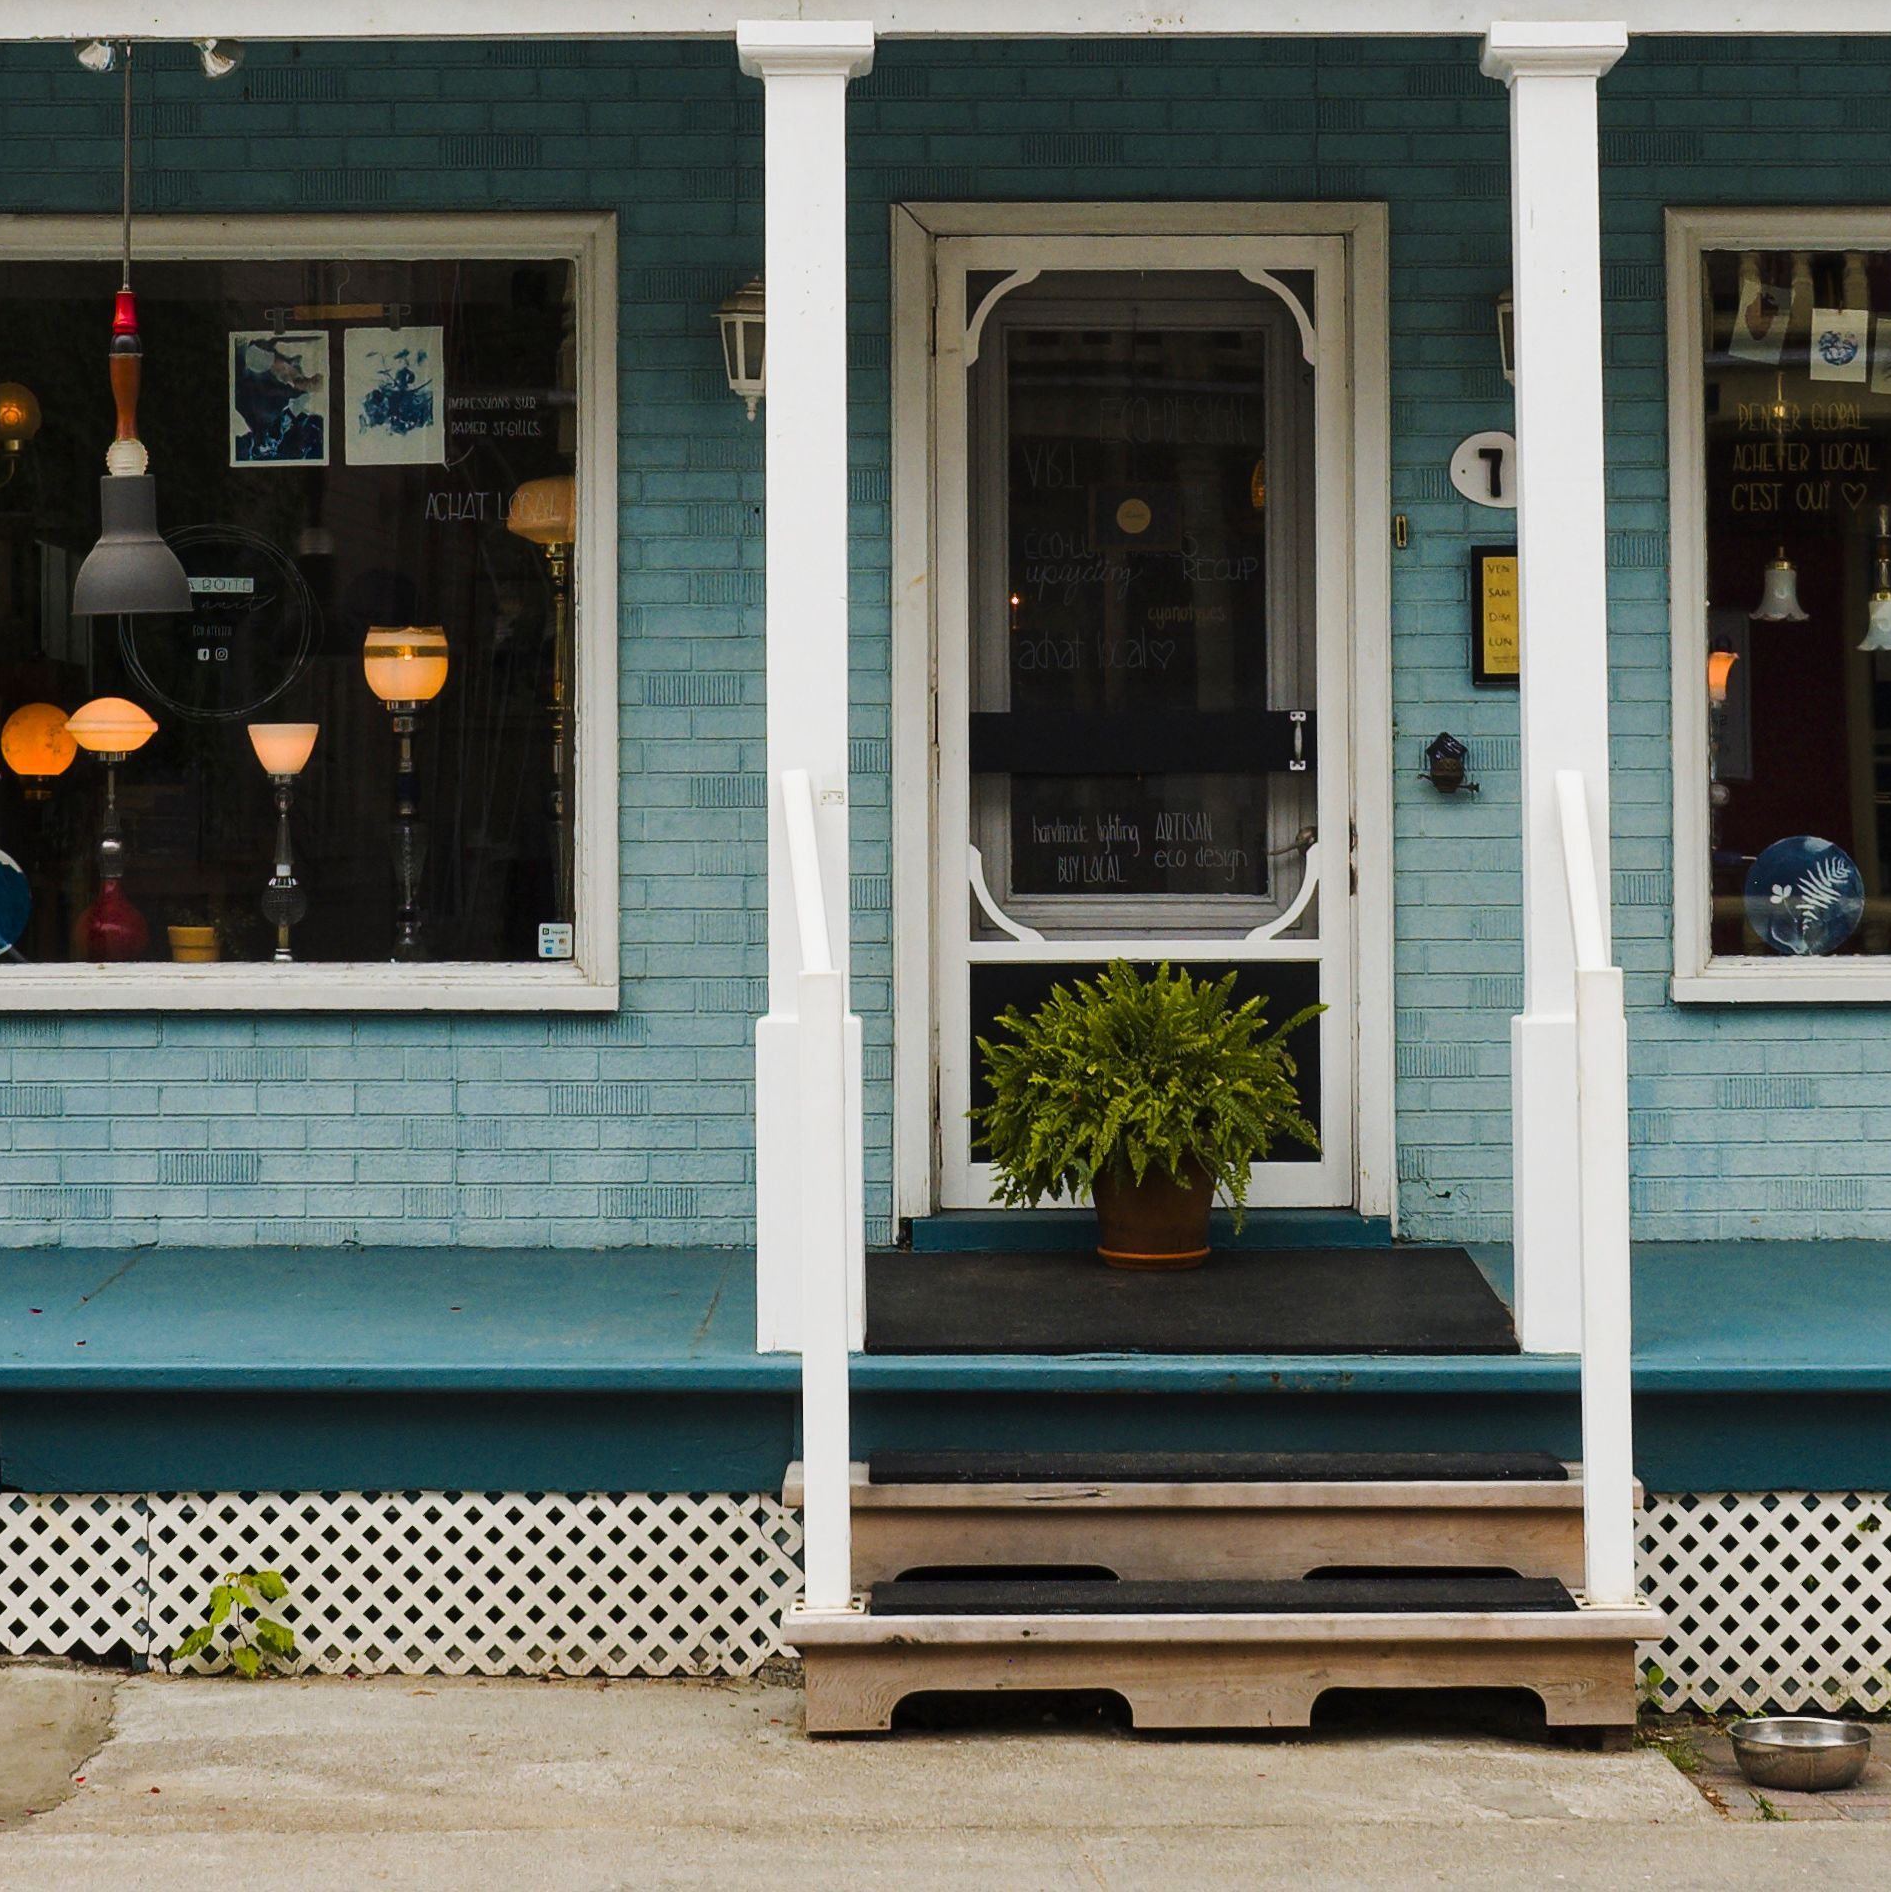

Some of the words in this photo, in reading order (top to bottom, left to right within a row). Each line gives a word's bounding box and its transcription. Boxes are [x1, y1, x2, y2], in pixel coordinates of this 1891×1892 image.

[1820, 442, 1879, 472] LOCAL
[1478, 448, 1503, 498] 7
[424, 491, 490, 522] ACHAT
[1731, 482, 1783, 512] C'EST
[1487, 564, 1510, 574] VEN
[1488, 588, 1511, 597] SAM
[1488, 612, 1511, 622] DIM
[1019, 630, 1085, 669] achat
[1097, 627, 1147, 669] local
[1488, 637, 1513, 647] LUN
[1032, 814, 1088, 844] handmade
[1096, 813, 1140, 858] lighting
[1155, 811, 1213, 841] ARTISAN
[1057, 855, 1079, 883] BUY
[1083, 854, 1128, 883] LOCAL
[1154, 849, 1187, 868] eco
[1195, 847, 1248, 882] design
